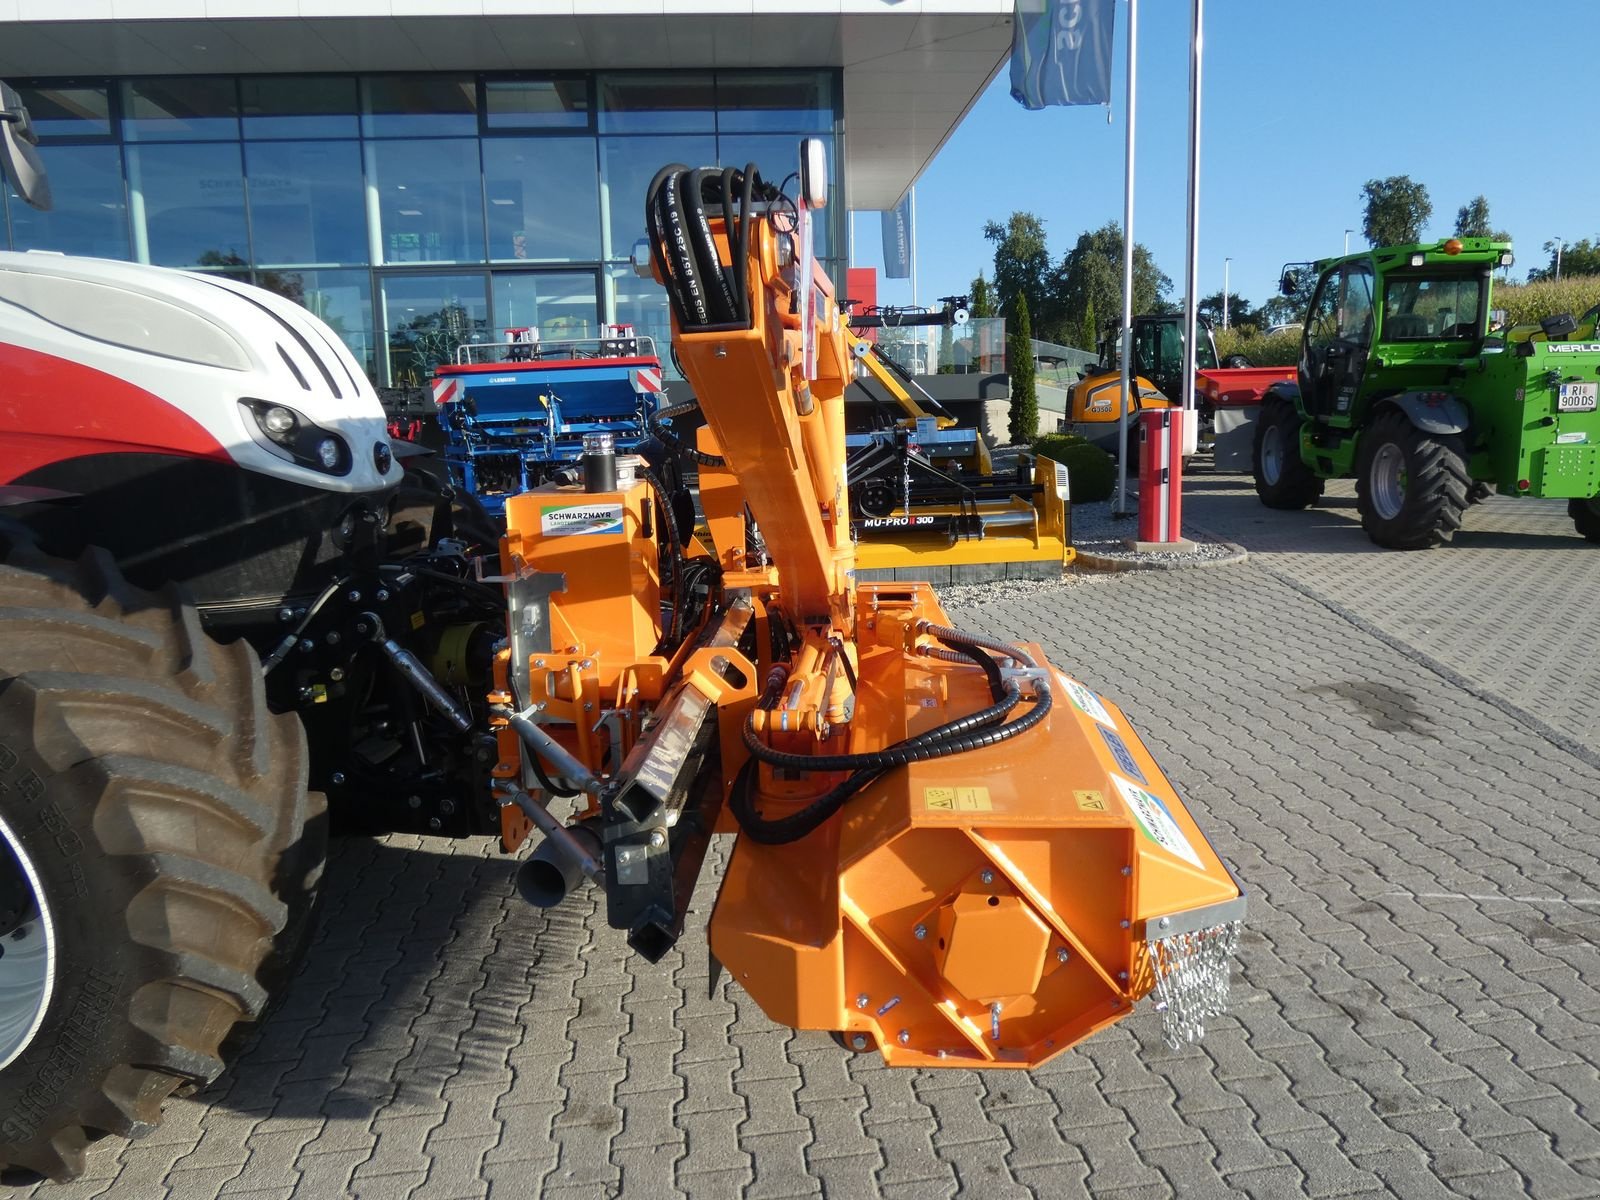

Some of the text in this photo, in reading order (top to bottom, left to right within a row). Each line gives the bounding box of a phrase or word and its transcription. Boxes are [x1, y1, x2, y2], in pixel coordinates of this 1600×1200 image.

[671, 211, 679, 224] 19
[674, 227, 687, 252] 2SC
[681, 256, 693, 276] 857
[688, 280, 700, 296] EN
[1548, 344, 1600, 353] MERLO
[1571, 385, 1582, 396] RI
[1562, 395, 1594, 407] 900 DS
[548, 511, 612, 521] SCHWARZMAYR
[864, 517, 909, 528] MU-PRO
[916, 516, 934, 524] 300
